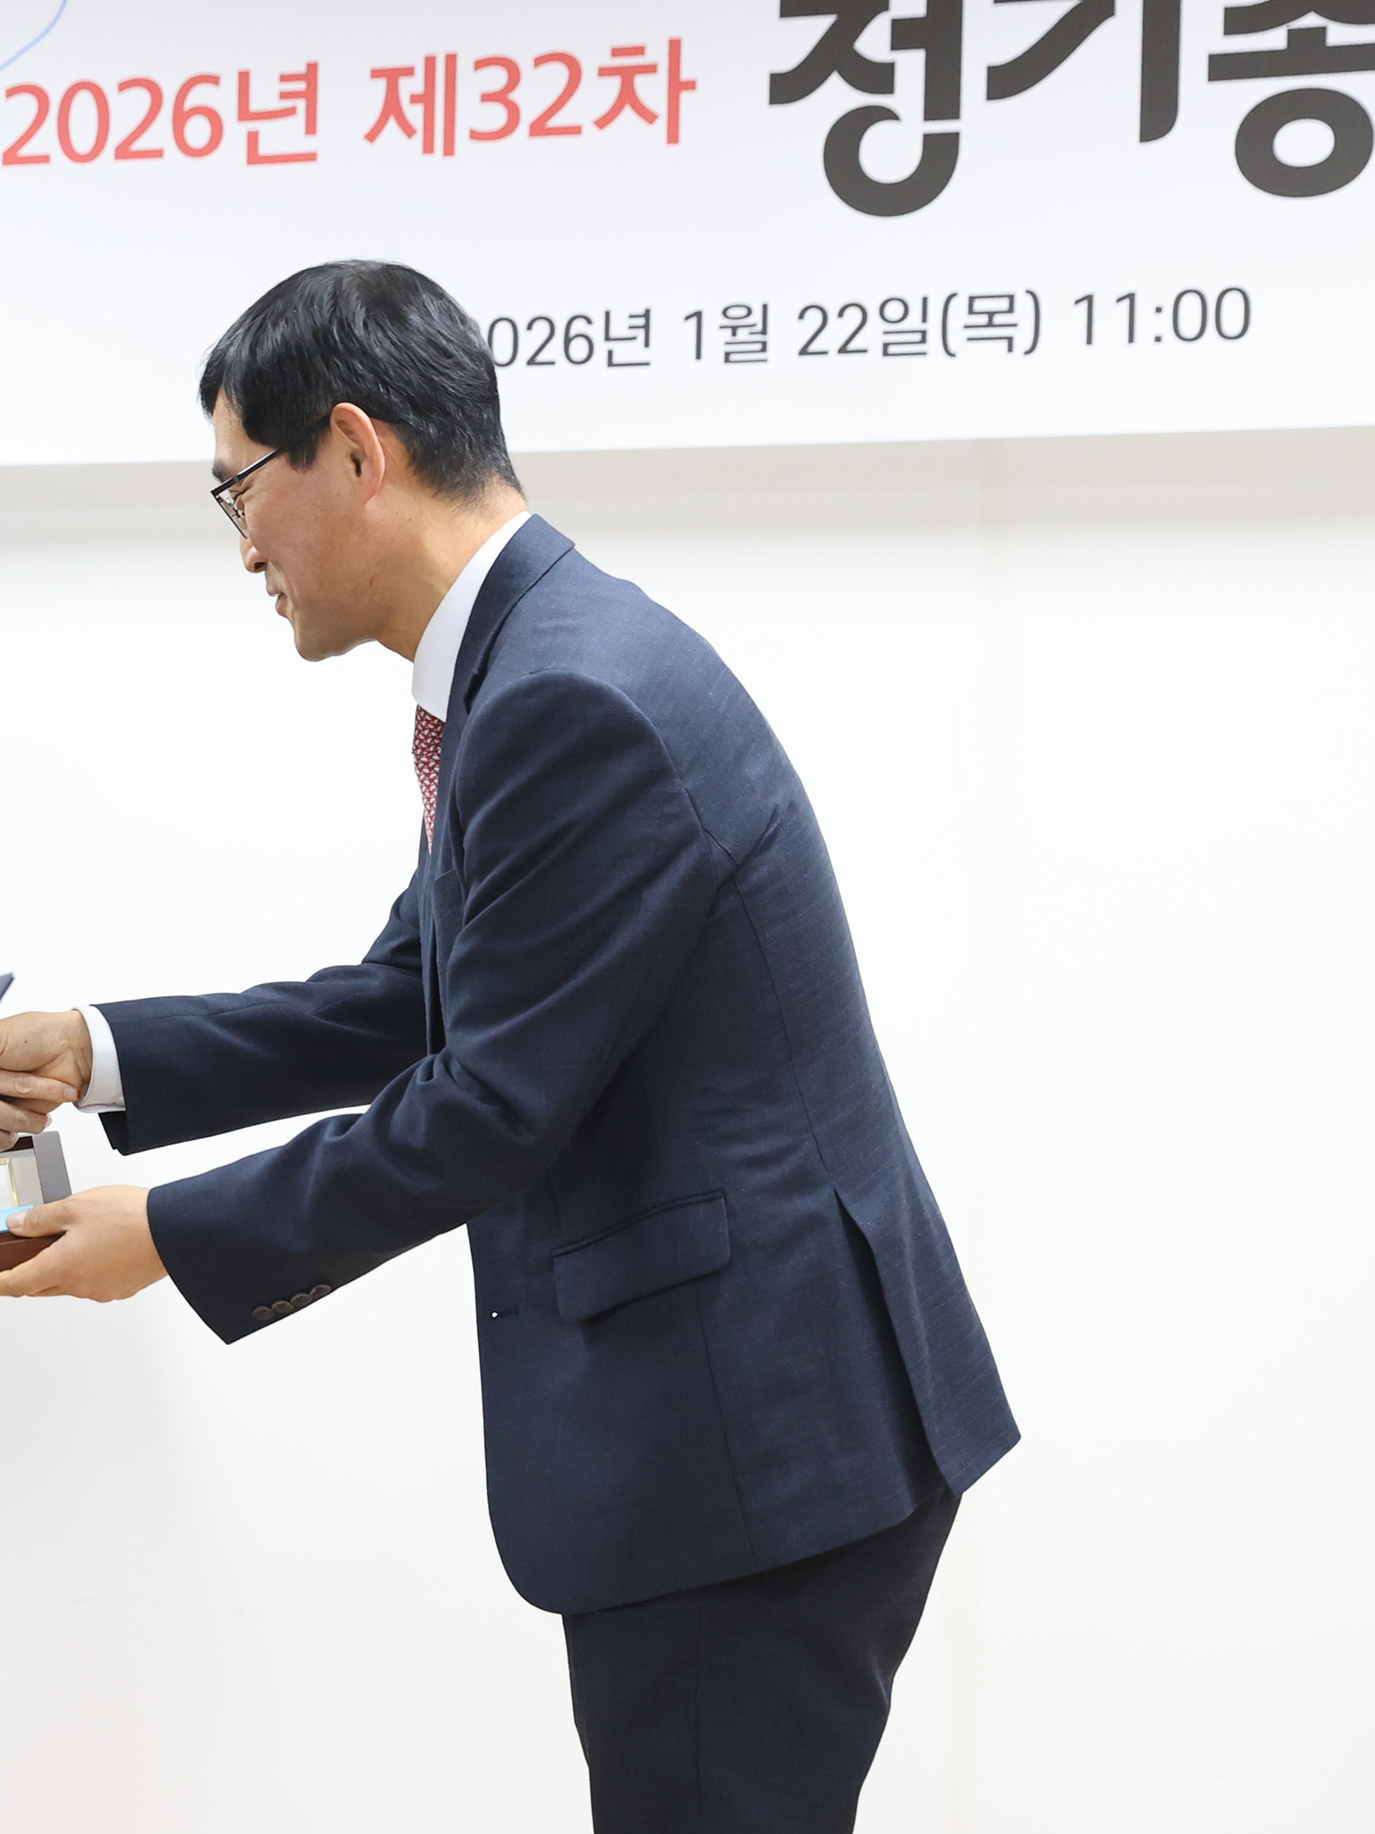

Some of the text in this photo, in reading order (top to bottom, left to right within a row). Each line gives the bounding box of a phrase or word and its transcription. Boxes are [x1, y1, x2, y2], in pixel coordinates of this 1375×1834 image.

[1, 61, 319, 167] 2026년
[363, 37, 698, 158] 제32차
[486, 286, 1251, 369] 026년 1월 22일(목) 11:00
